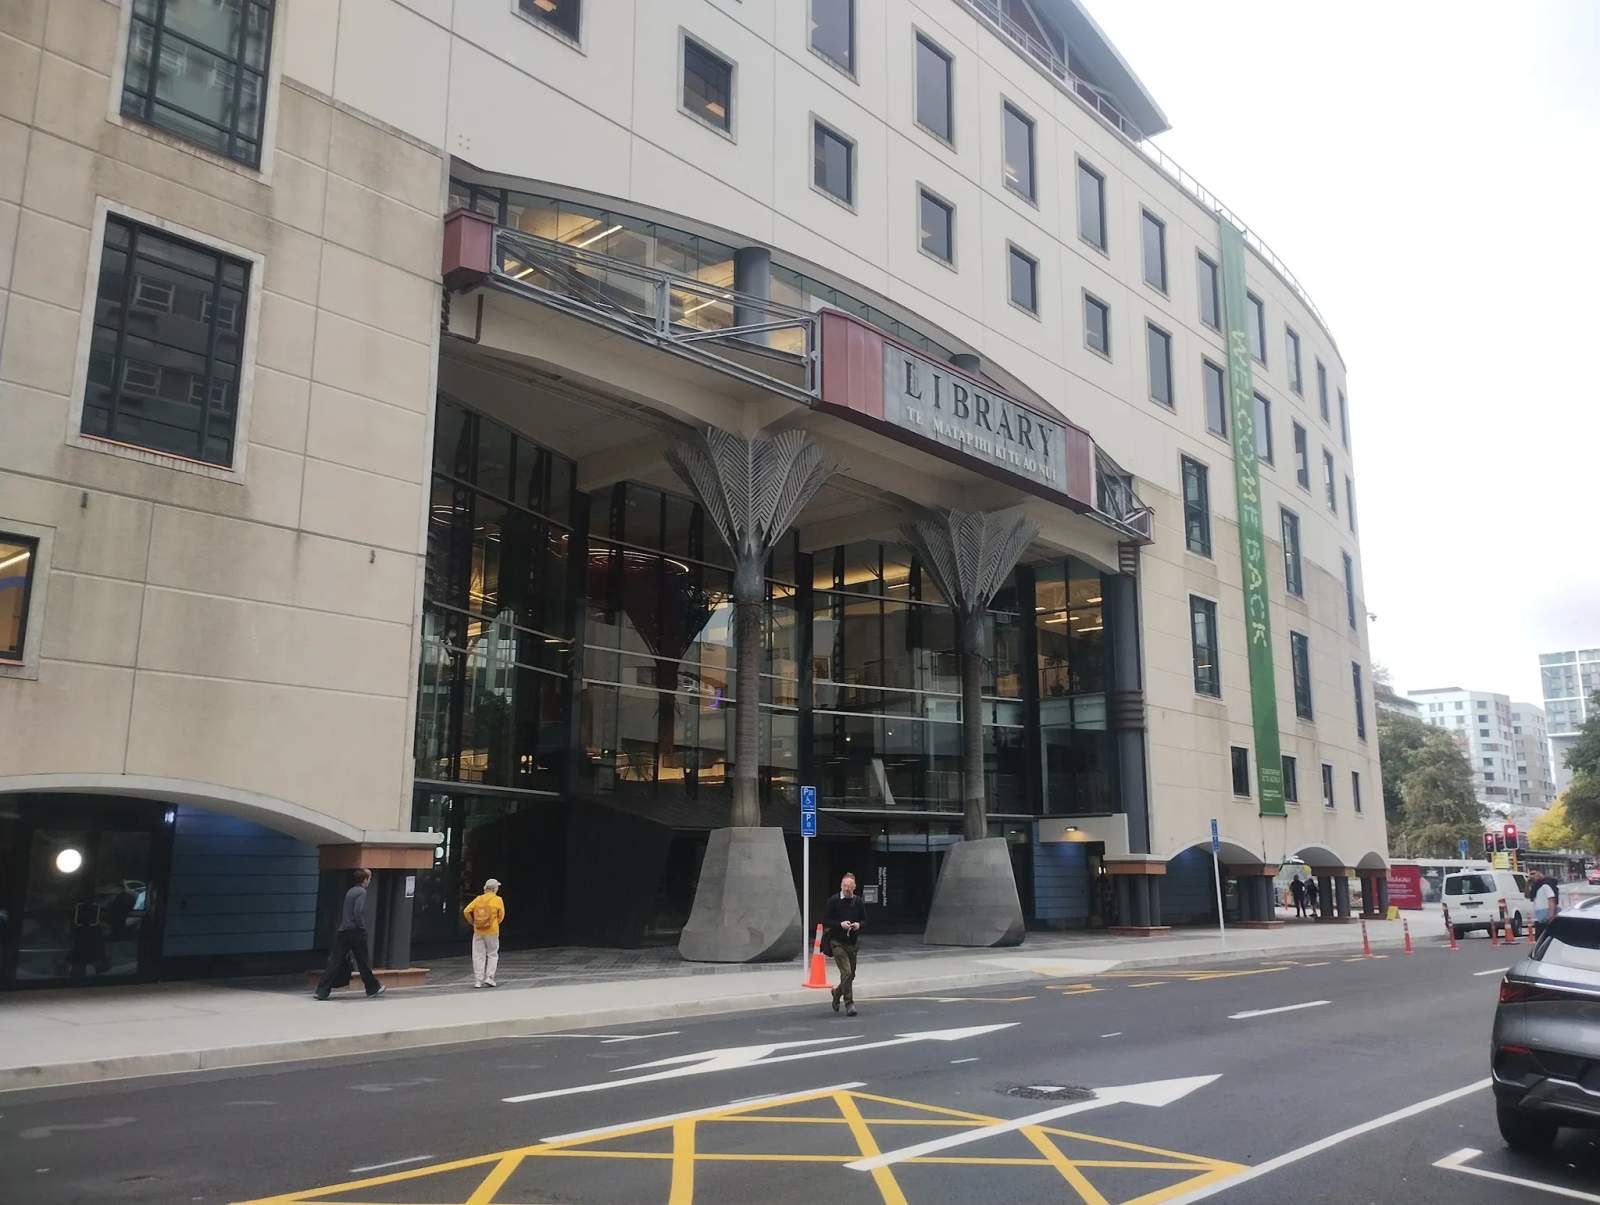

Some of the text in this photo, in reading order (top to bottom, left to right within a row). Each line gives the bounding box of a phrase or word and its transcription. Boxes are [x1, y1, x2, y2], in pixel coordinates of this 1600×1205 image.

[904, 359, 1053, 456] LIBRARY
[907, 407, 1056, 482] TE MATAPIHI KI TE AO NUI
[1231, 329, 1267, 647] WELCOME BACK
